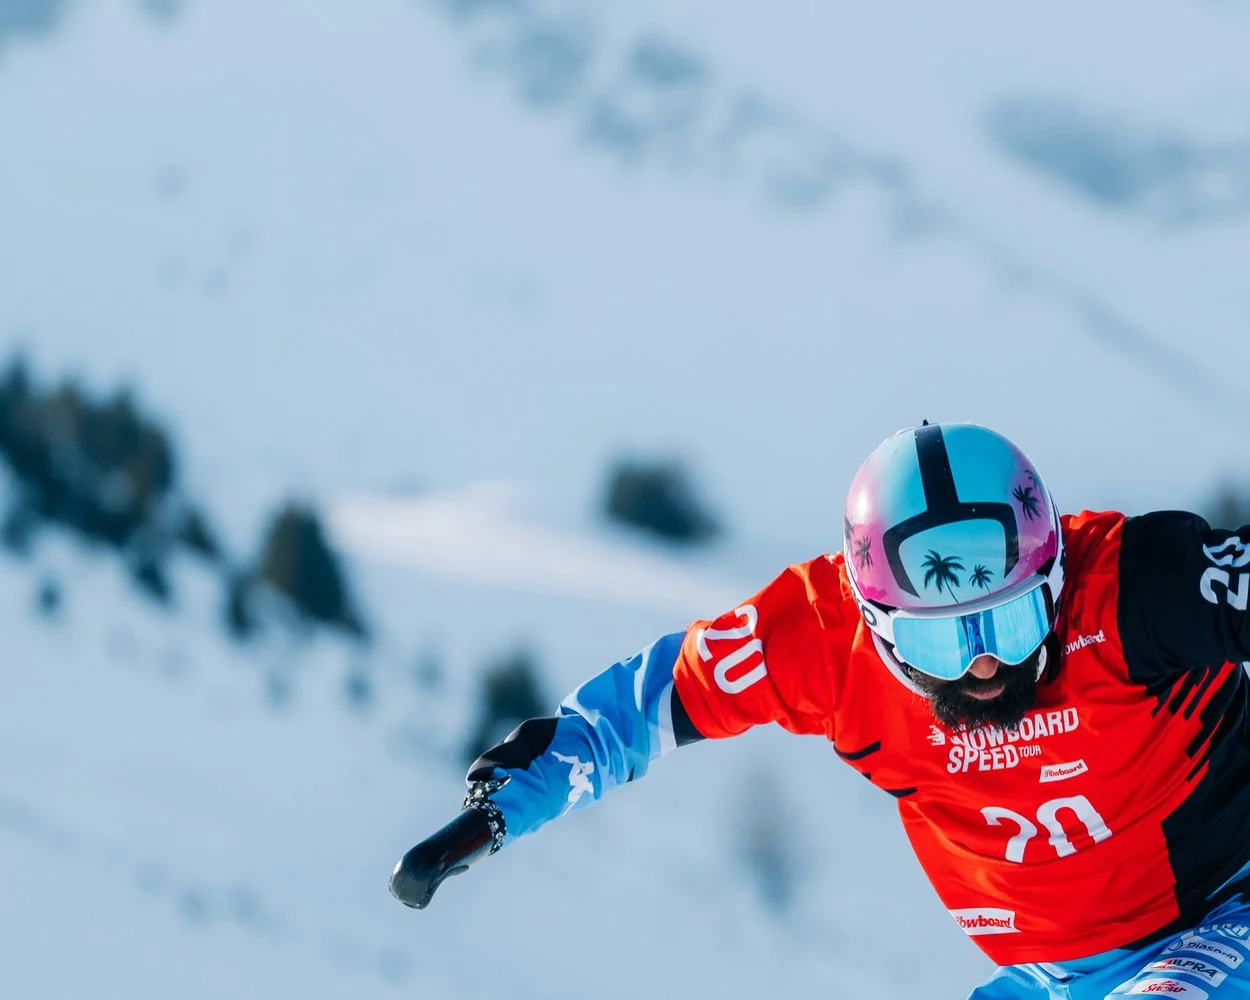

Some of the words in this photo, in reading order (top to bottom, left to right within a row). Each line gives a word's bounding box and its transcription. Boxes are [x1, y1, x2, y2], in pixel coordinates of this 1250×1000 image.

[697, 604, 767, 694] 20
[947, 744, 1019, 774] SPEED
[1018, 744, 1042, 758] TOUR
